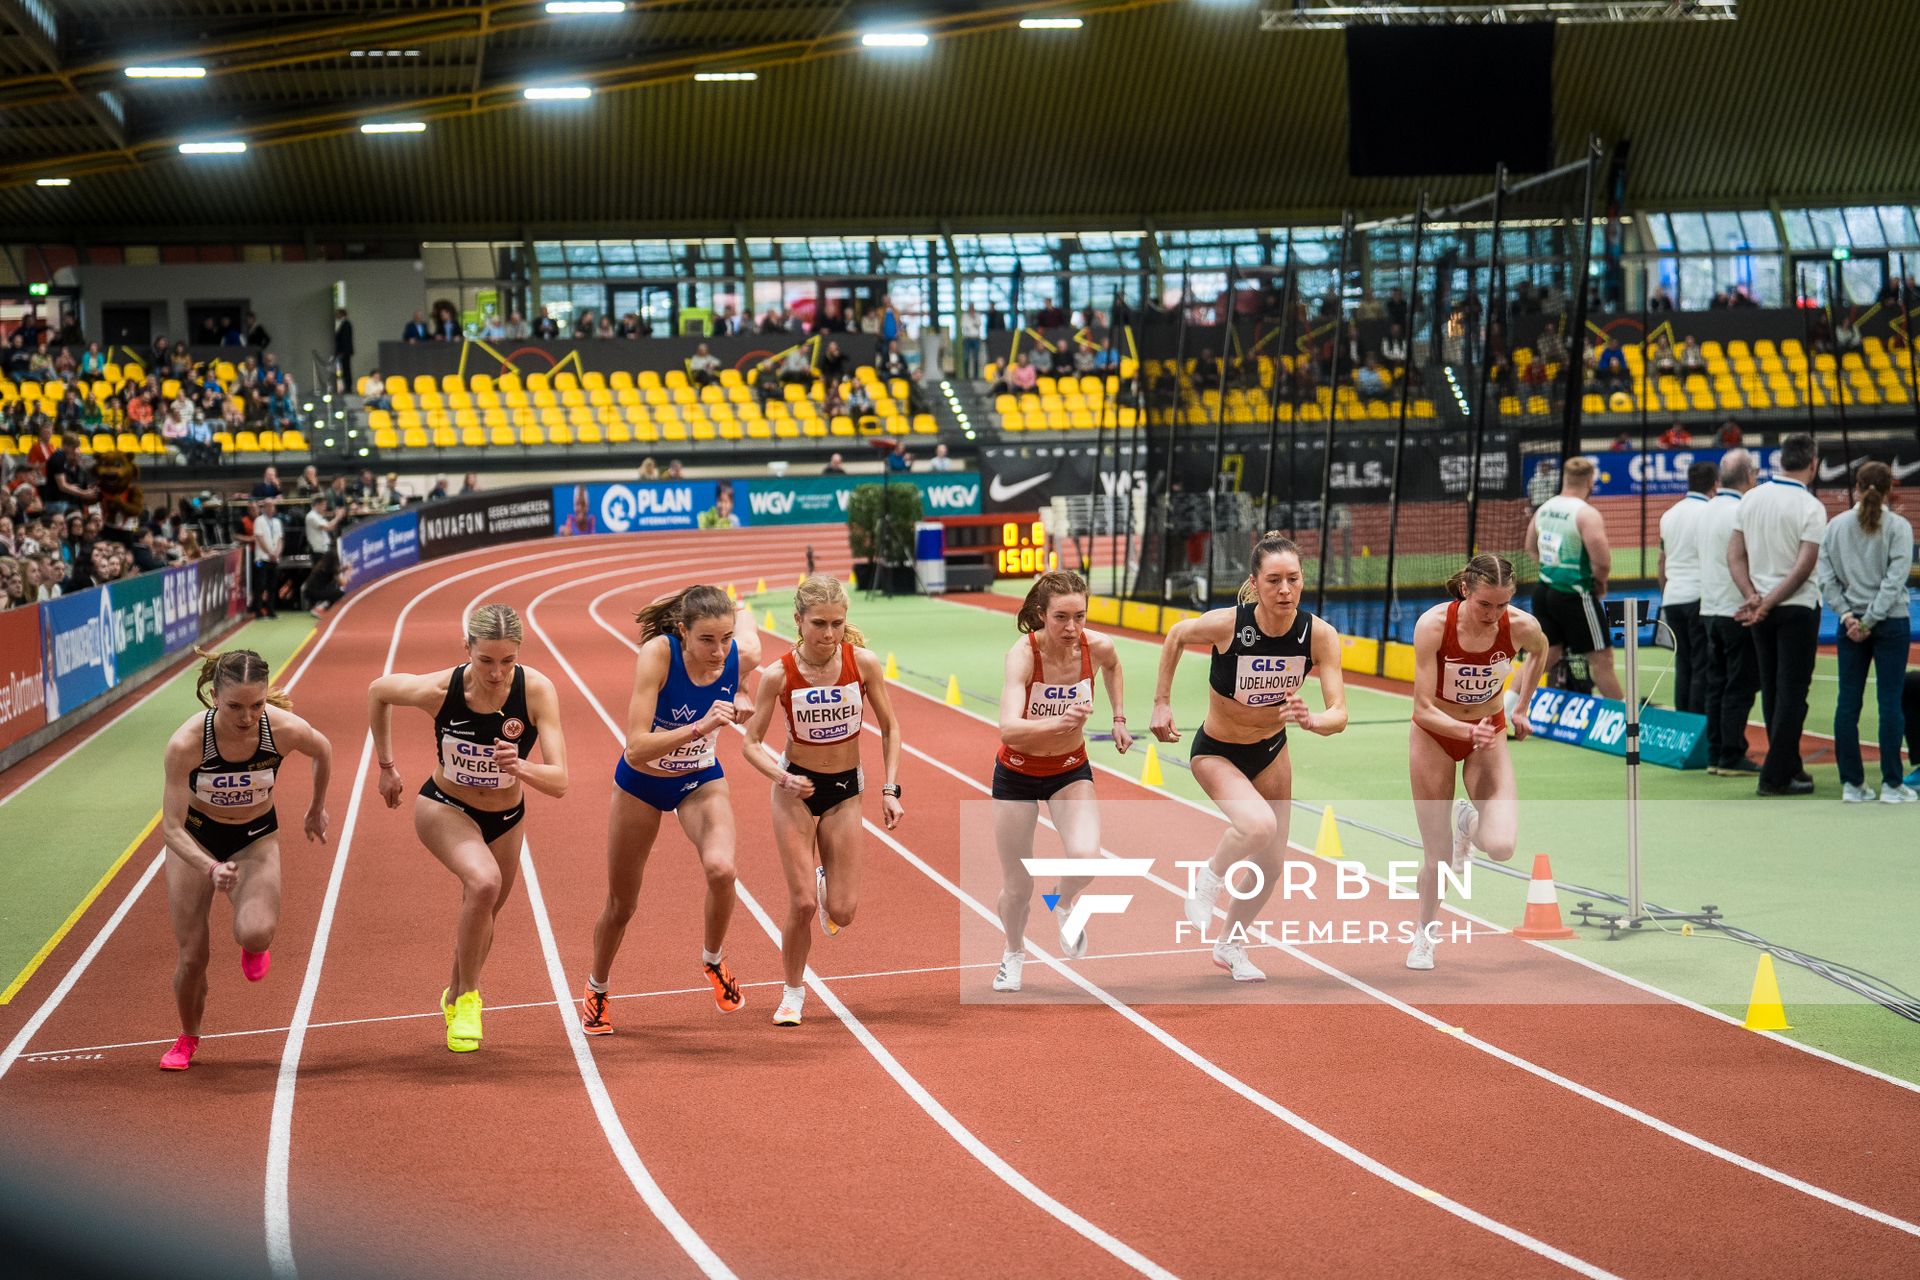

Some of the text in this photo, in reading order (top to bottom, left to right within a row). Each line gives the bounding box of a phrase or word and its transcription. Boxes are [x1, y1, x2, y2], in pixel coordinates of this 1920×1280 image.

[638, 487, 692, 514] PLAN
[749, 491, 795, 515] WGV
[928, 484, 979, 508] WGV
[427, 512, 485, 540] NOVAFON
[1240, 676, 1301, 690] UDELHOVEN
[1455, 678, 1499, 690] KLUG
[1262, 693, 1284, 701] PLAN
[1472, 691, 1492, 701] PLAN
[797, 705, 858, 723] MERKEL
[825, 726, 847, 735] PLAN
[1589, 708, 1627, 745] WGV
[676, 761, 698, 769] PLAN
[228, 795, 251, 804] PLAN
